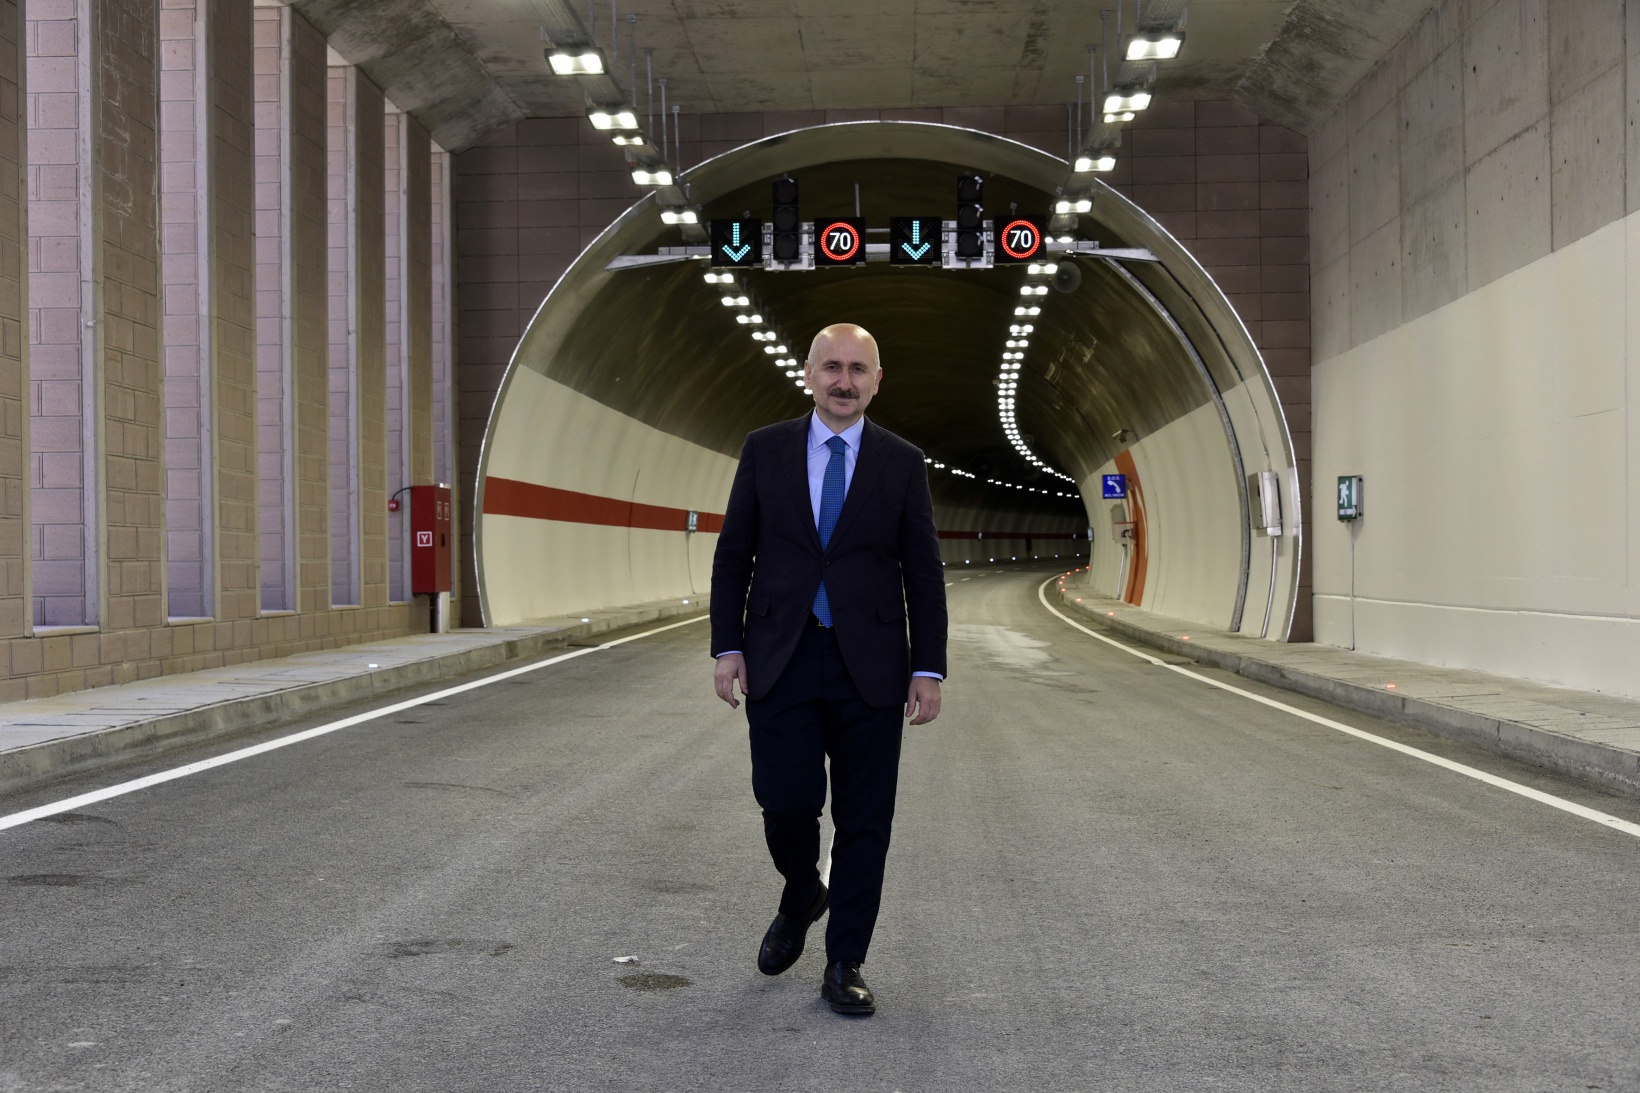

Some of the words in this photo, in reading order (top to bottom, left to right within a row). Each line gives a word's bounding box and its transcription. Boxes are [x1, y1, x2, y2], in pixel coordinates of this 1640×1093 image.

[829, 232, 851, 250] 70
[1010, 230, 1032, 248] 70
[420, 534, 429, 543] Y
